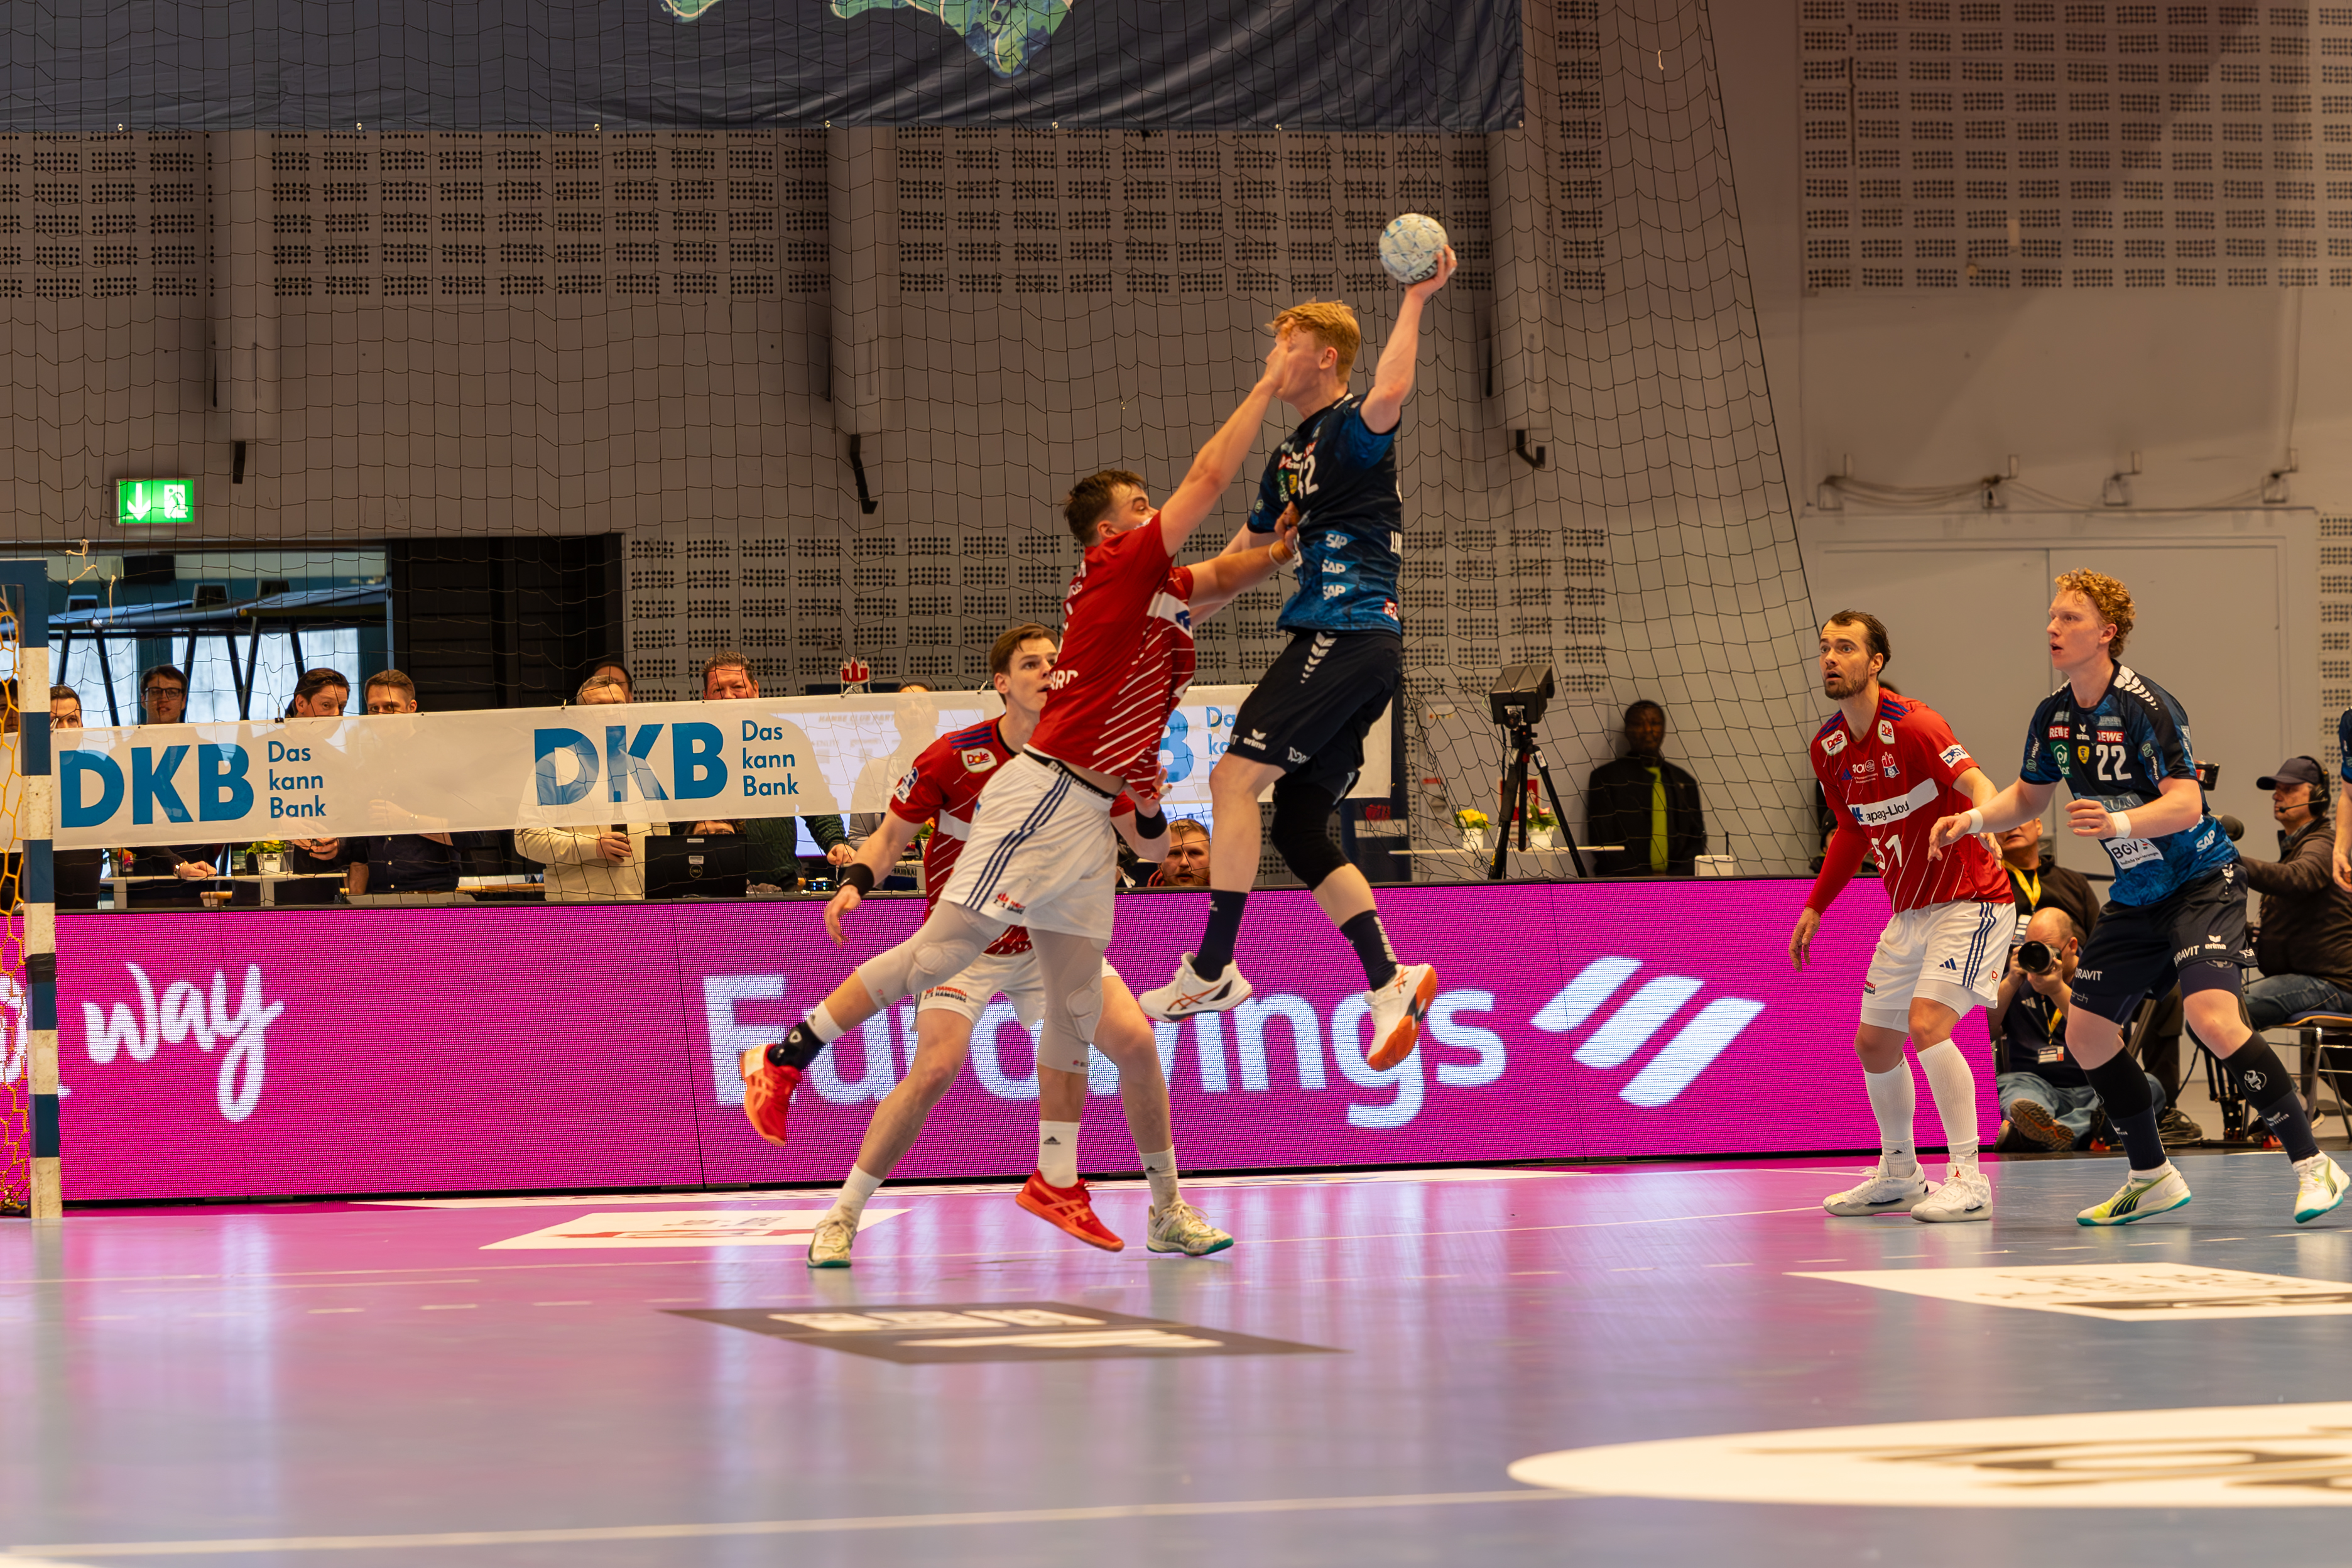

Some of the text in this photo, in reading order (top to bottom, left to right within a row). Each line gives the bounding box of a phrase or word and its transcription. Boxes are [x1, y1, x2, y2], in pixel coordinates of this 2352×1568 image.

[1322, 559, 1346, 574] SAP
[1323, 585, 1346, 600] SAP
[1206, 706, 1236, 727] Da
[743, 720, 783, 742] Das
[2049, 727, 2069, 738] REWE
[268, 741, 312, 763] Das
[1243, 737, 1266, 751] erima
[534, 722, 728, 807] DKB
[743, 748, 796, 770] kann
[966, 751, 991, 765] Dole
[2096, 744, 2132, 781] 22
[58, 743, 254, 828] DKB
[269, 770, 324, 791] kann
[744, 773, 799, 797] Bank
[270, 797, 327, 819] Bank
[2111, 841, 2138, 859] BGV
[2196, 830, 2215, 852] SAP
[82, 962, 285, 1122] way
